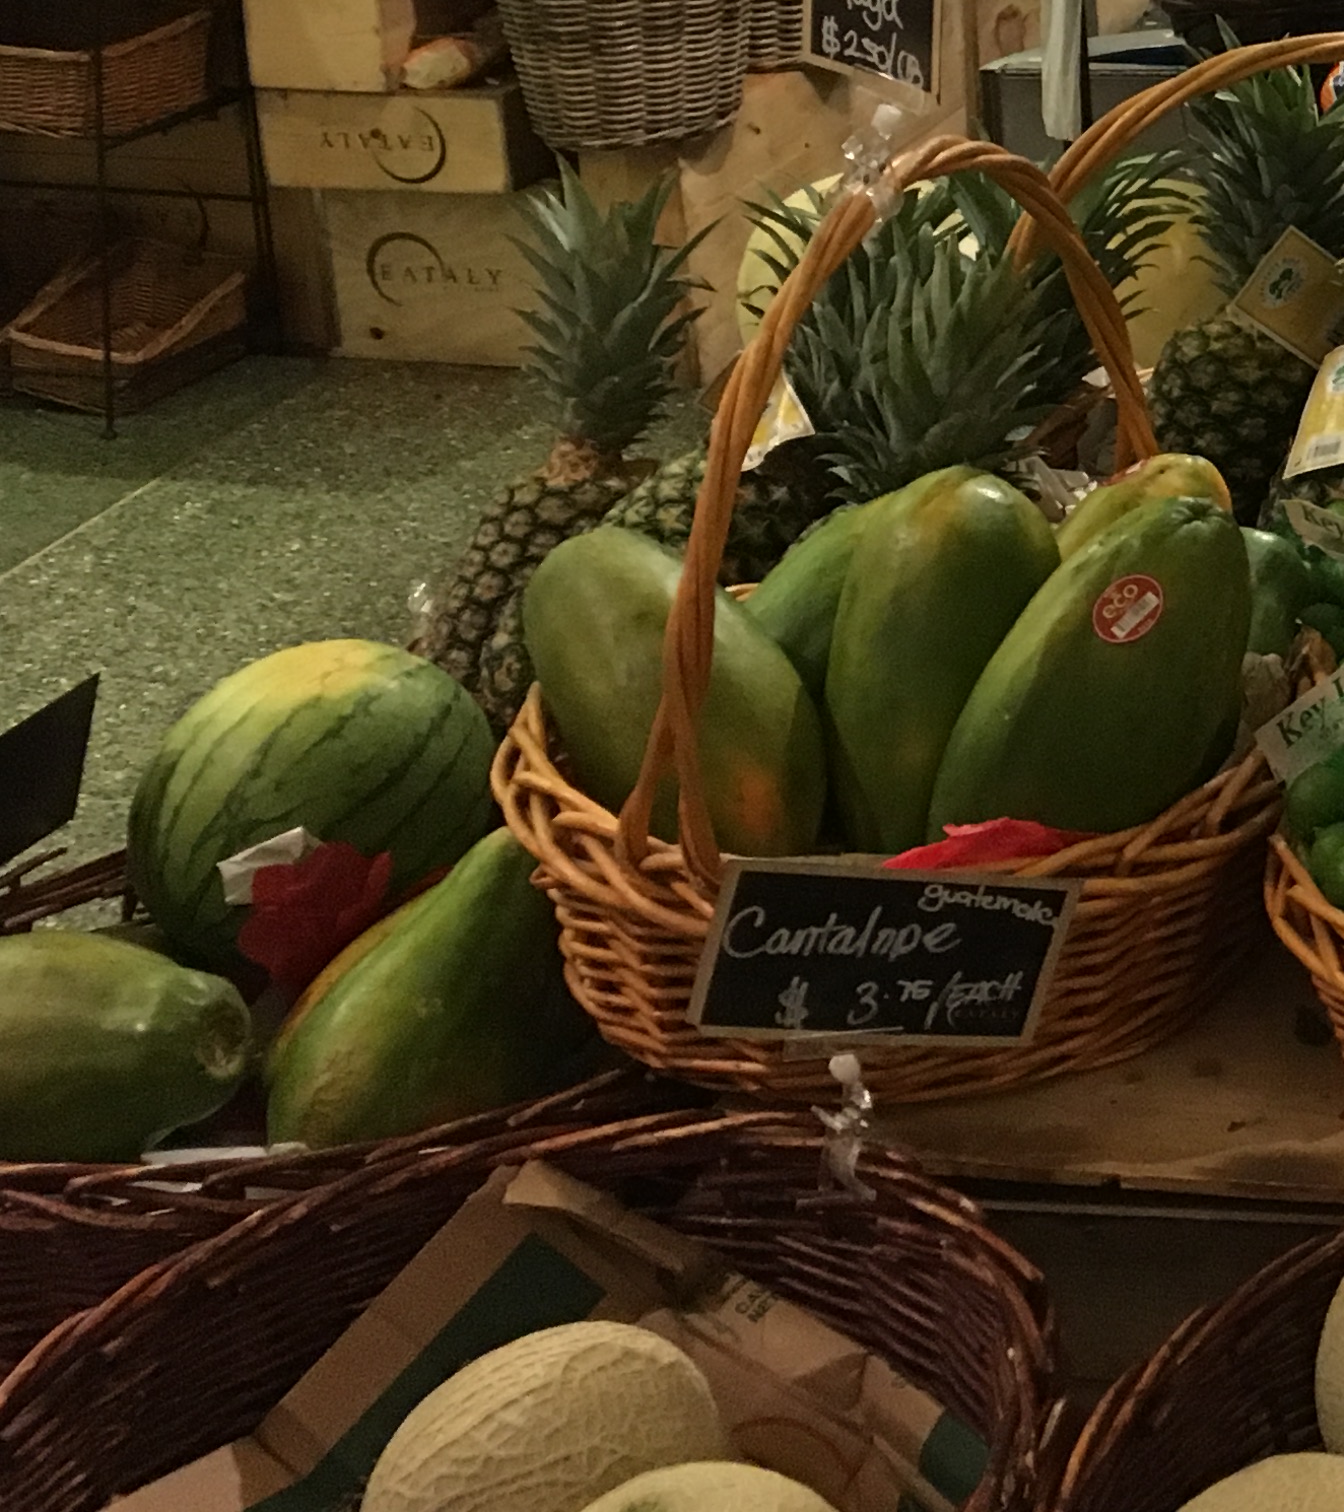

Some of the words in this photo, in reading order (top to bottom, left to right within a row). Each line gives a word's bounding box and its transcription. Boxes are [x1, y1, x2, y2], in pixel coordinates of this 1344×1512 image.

[318, 128, 436, 154] EATALY
[378, 262, 504, 288] EATALY
[1300, 504, 1344, 539] Key
[1276, 695, 1328, 749] Key
